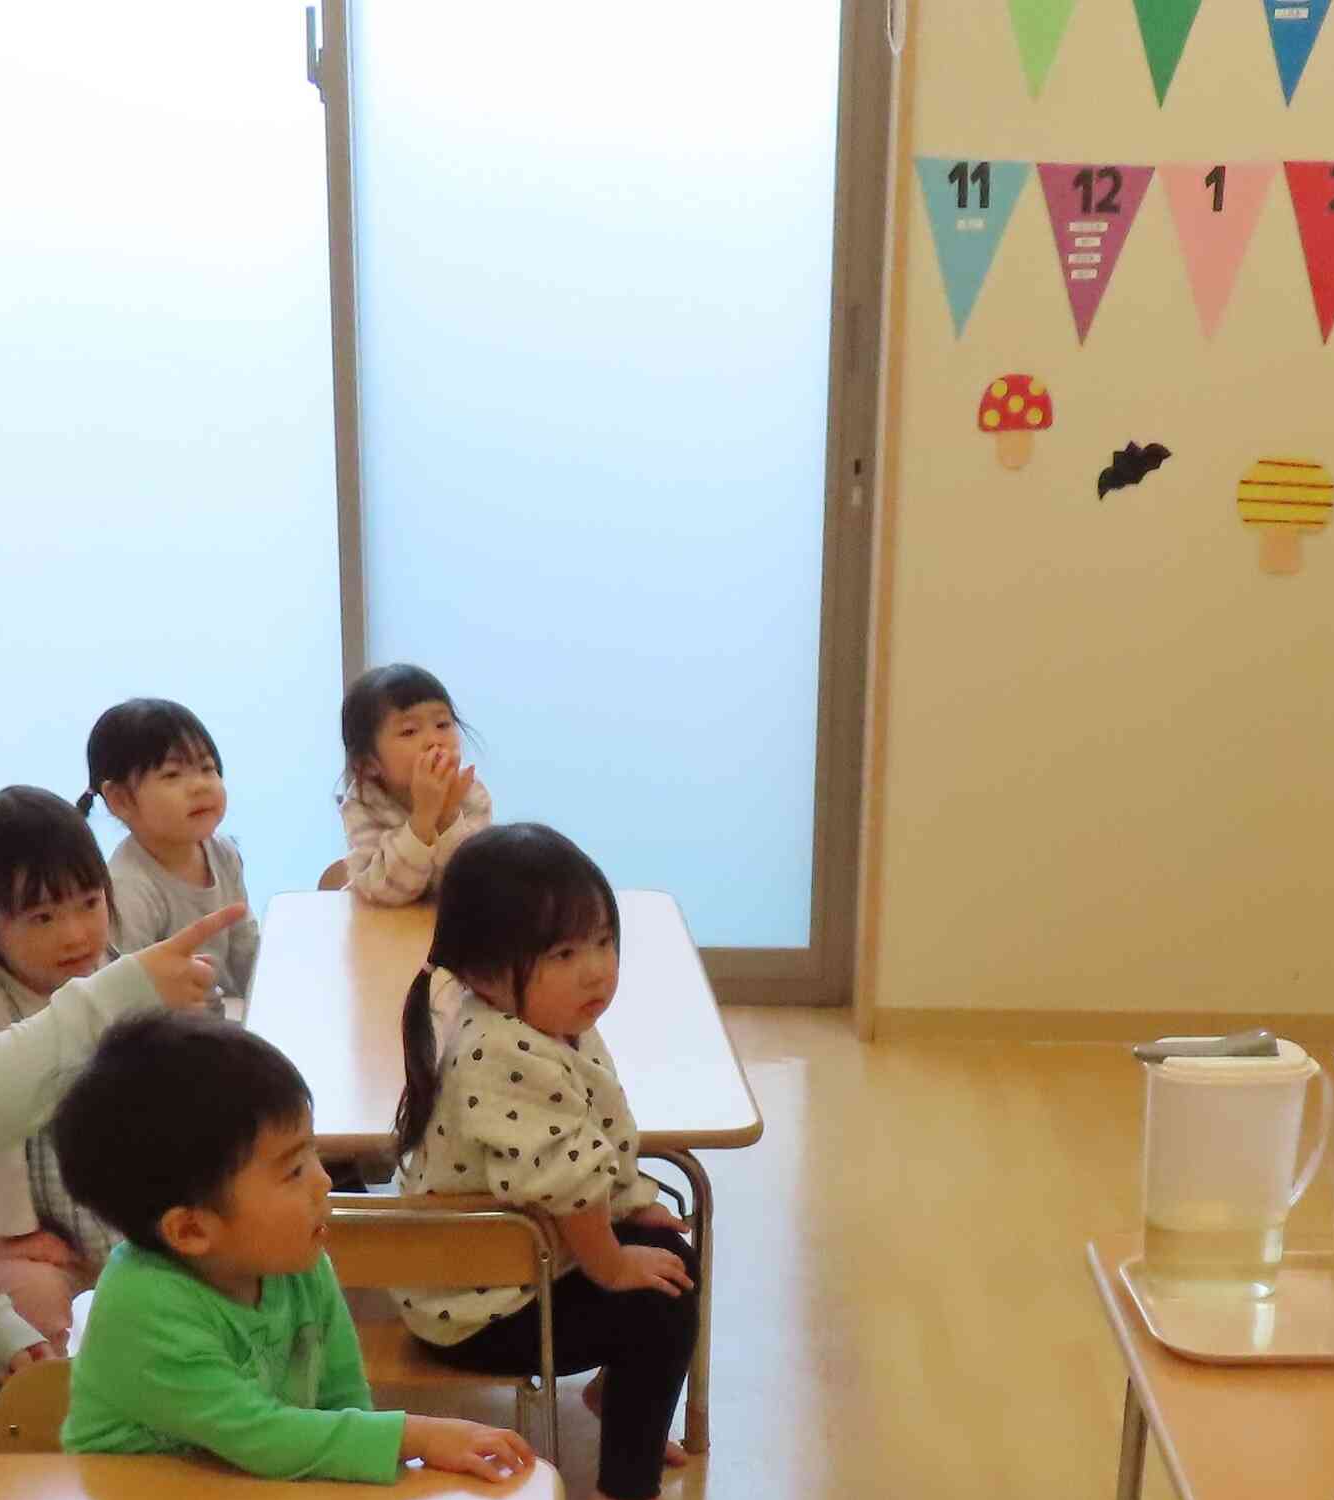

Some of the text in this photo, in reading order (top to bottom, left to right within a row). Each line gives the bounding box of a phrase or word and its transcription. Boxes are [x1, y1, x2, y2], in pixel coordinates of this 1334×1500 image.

[948, 161, 991, 208] 11
[1072, 166, 1123, 214] 12
[1205, 165, 1226, 212] 1
